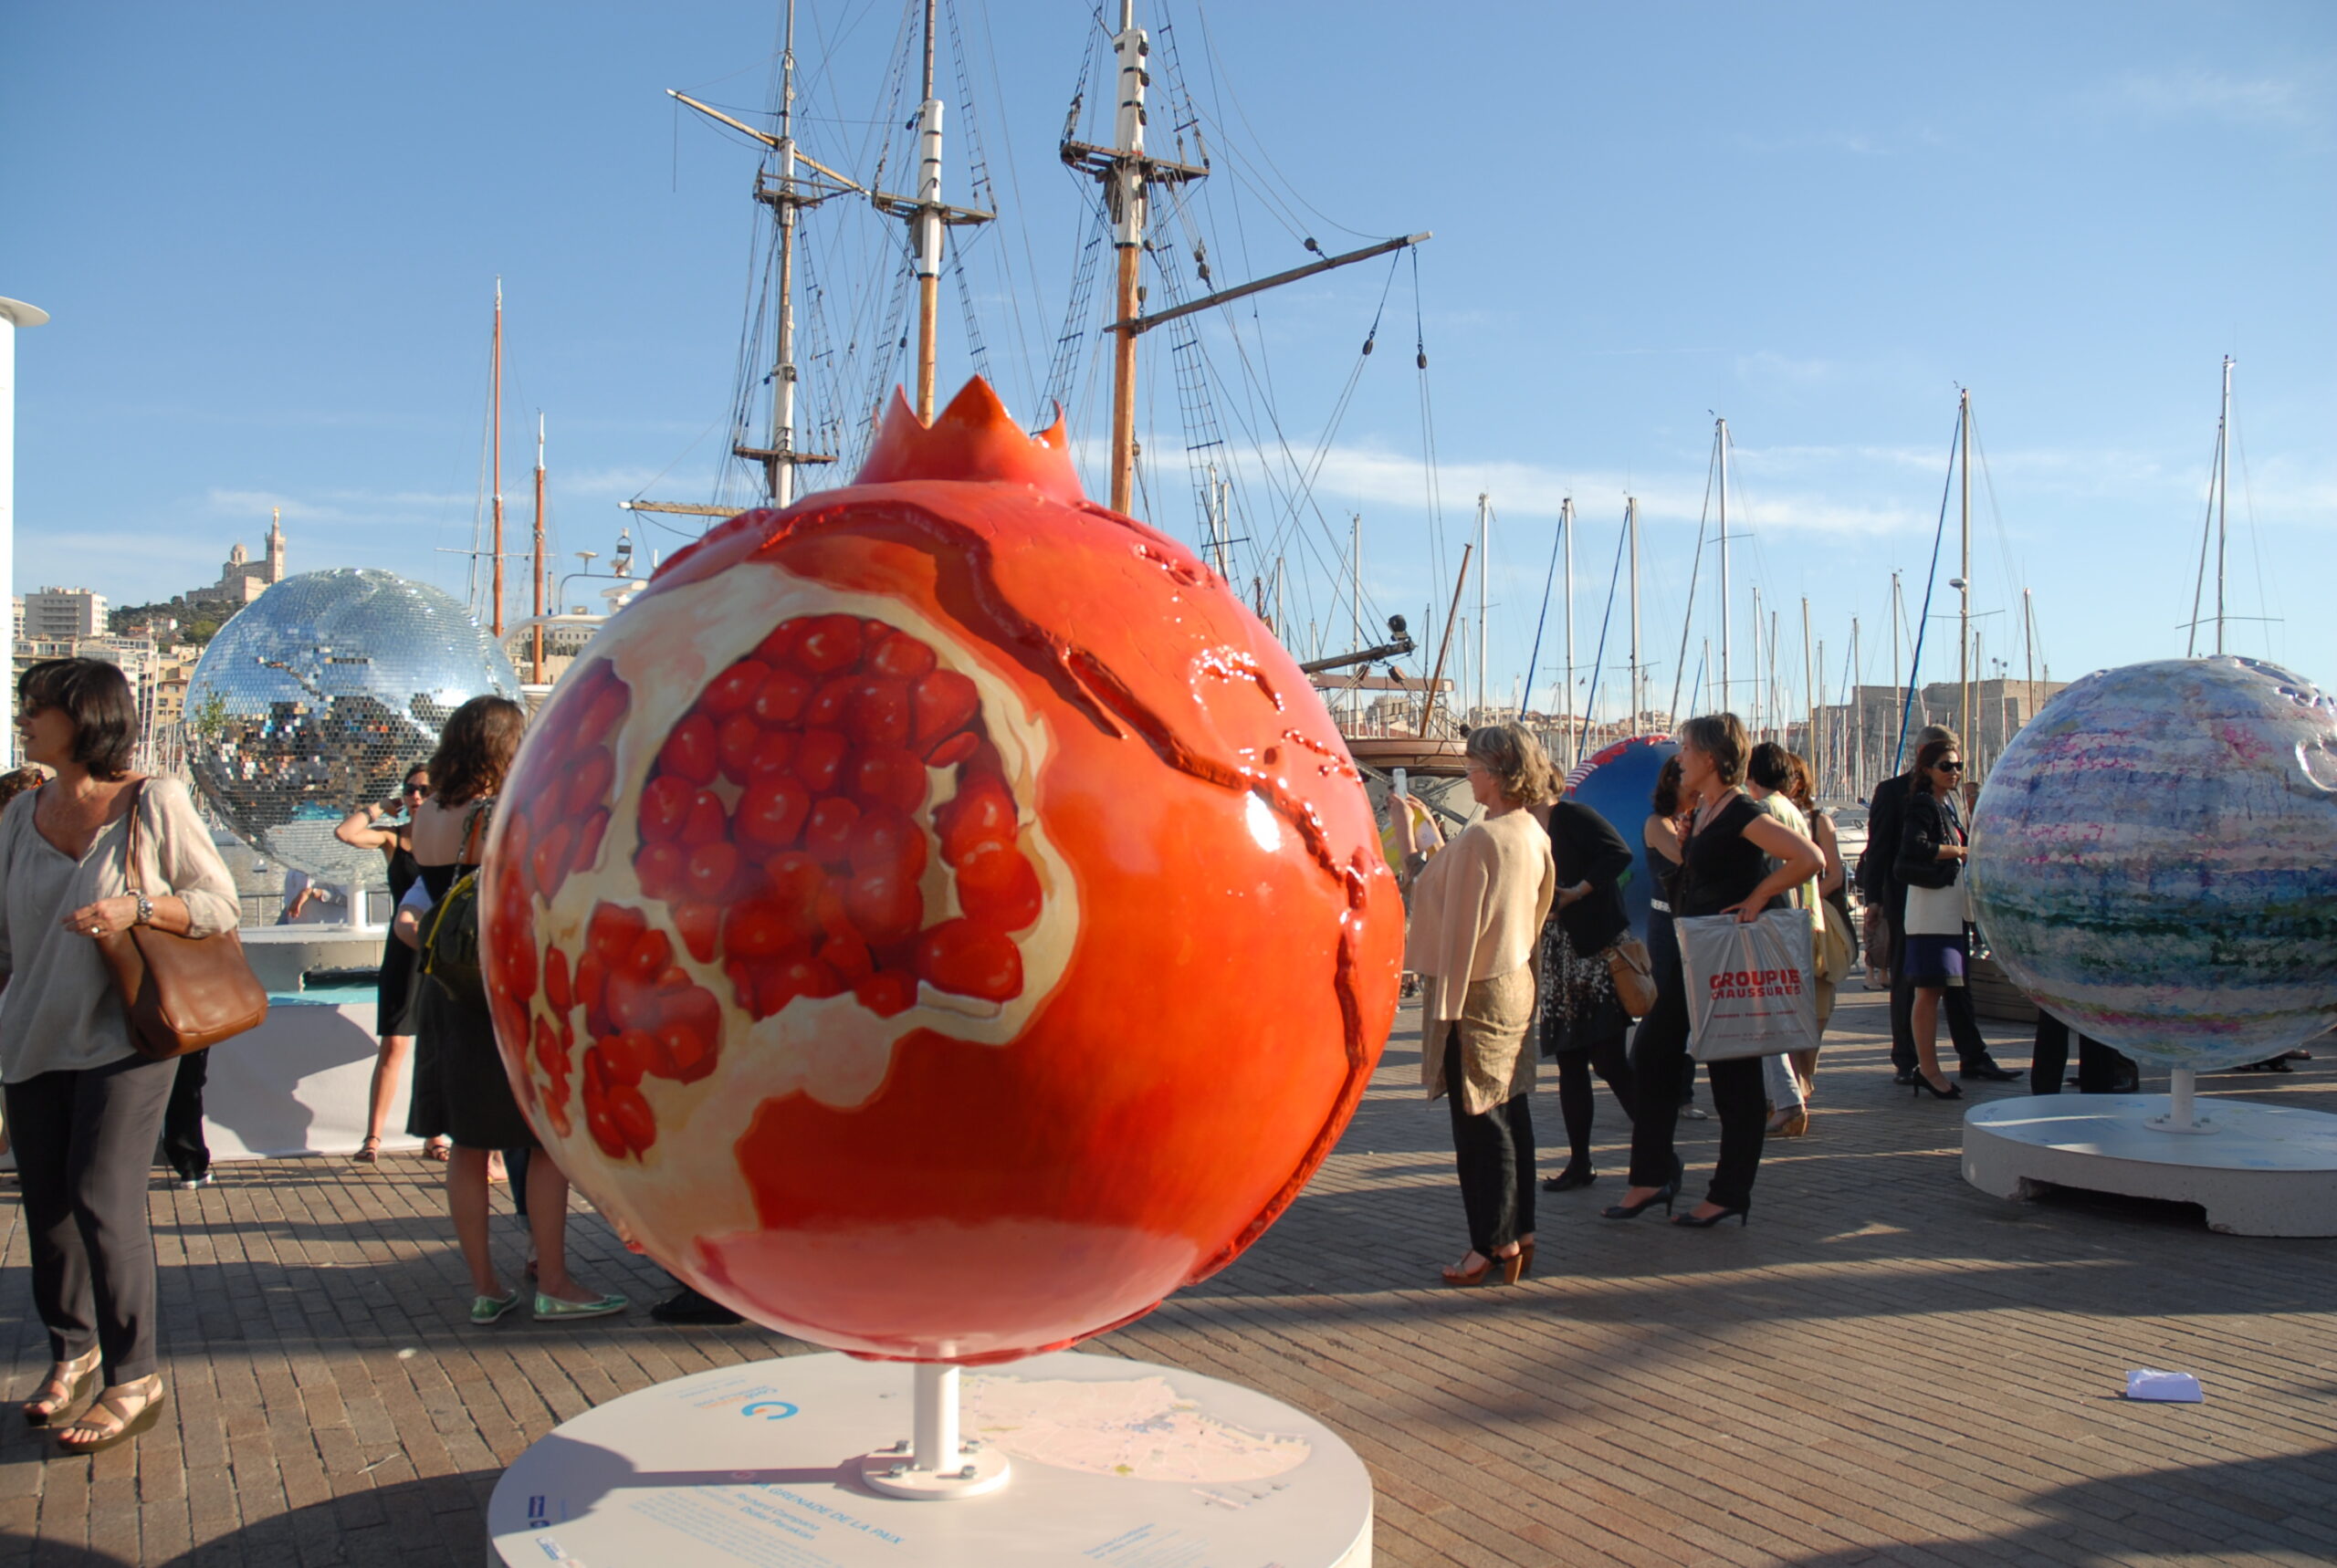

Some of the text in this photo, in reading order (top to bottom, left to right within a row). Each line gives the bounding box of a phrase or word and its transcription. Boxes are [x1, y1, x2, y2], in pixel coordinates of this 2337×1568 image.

[1710, 969, 1799, 989] GROUPIE
[1711, 986, 1801, 1000] CHAUSSURES
[769, 1488, 832, 1515] GRENADE
[831, 1512, 853, 1525] DE
[850, 1521, 872, 1532] LA
[870, 1528, 905, 1544] PAIX
